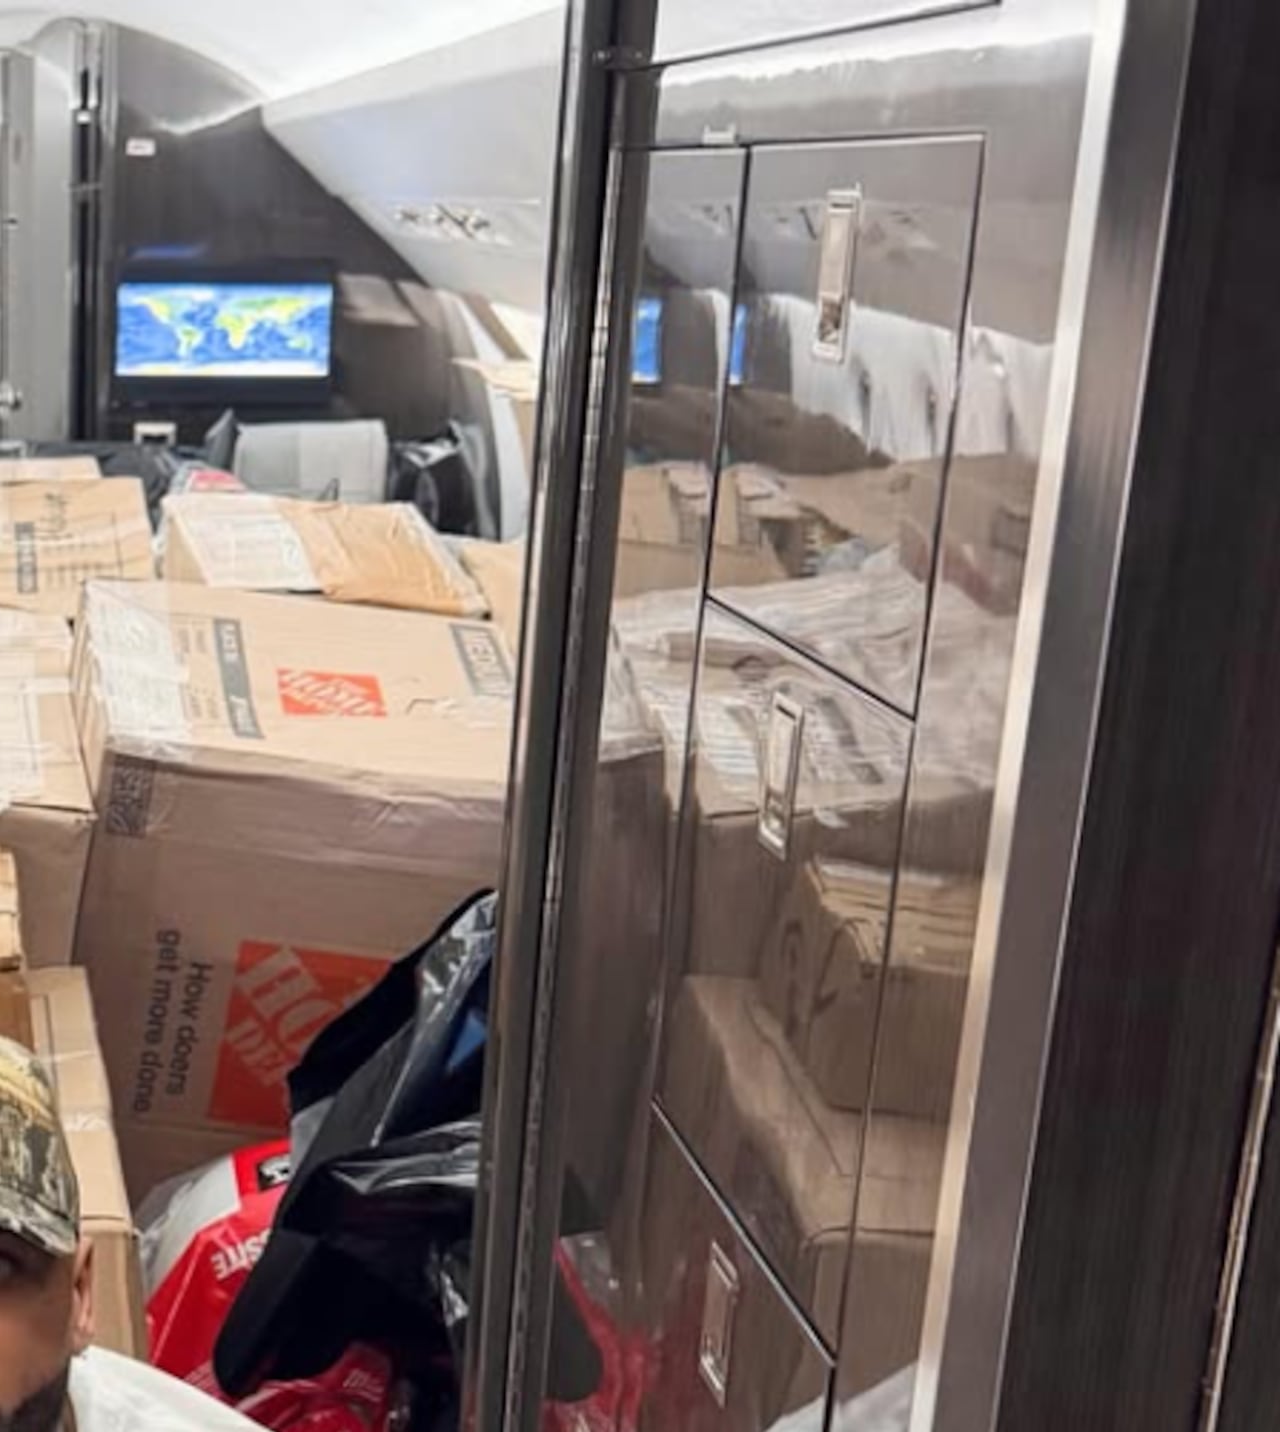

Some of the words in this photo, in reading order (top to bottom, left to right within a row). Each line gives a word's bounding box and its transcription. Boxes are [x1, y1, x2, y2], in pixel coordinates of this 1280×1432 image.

[154, 929, 182, 972] get
[143, 977, 173, 1045] more
[180, 961, 214, 1020] How
[132, 1051, 164, 1113] done
[163, 1025, 201, 1097] doers
